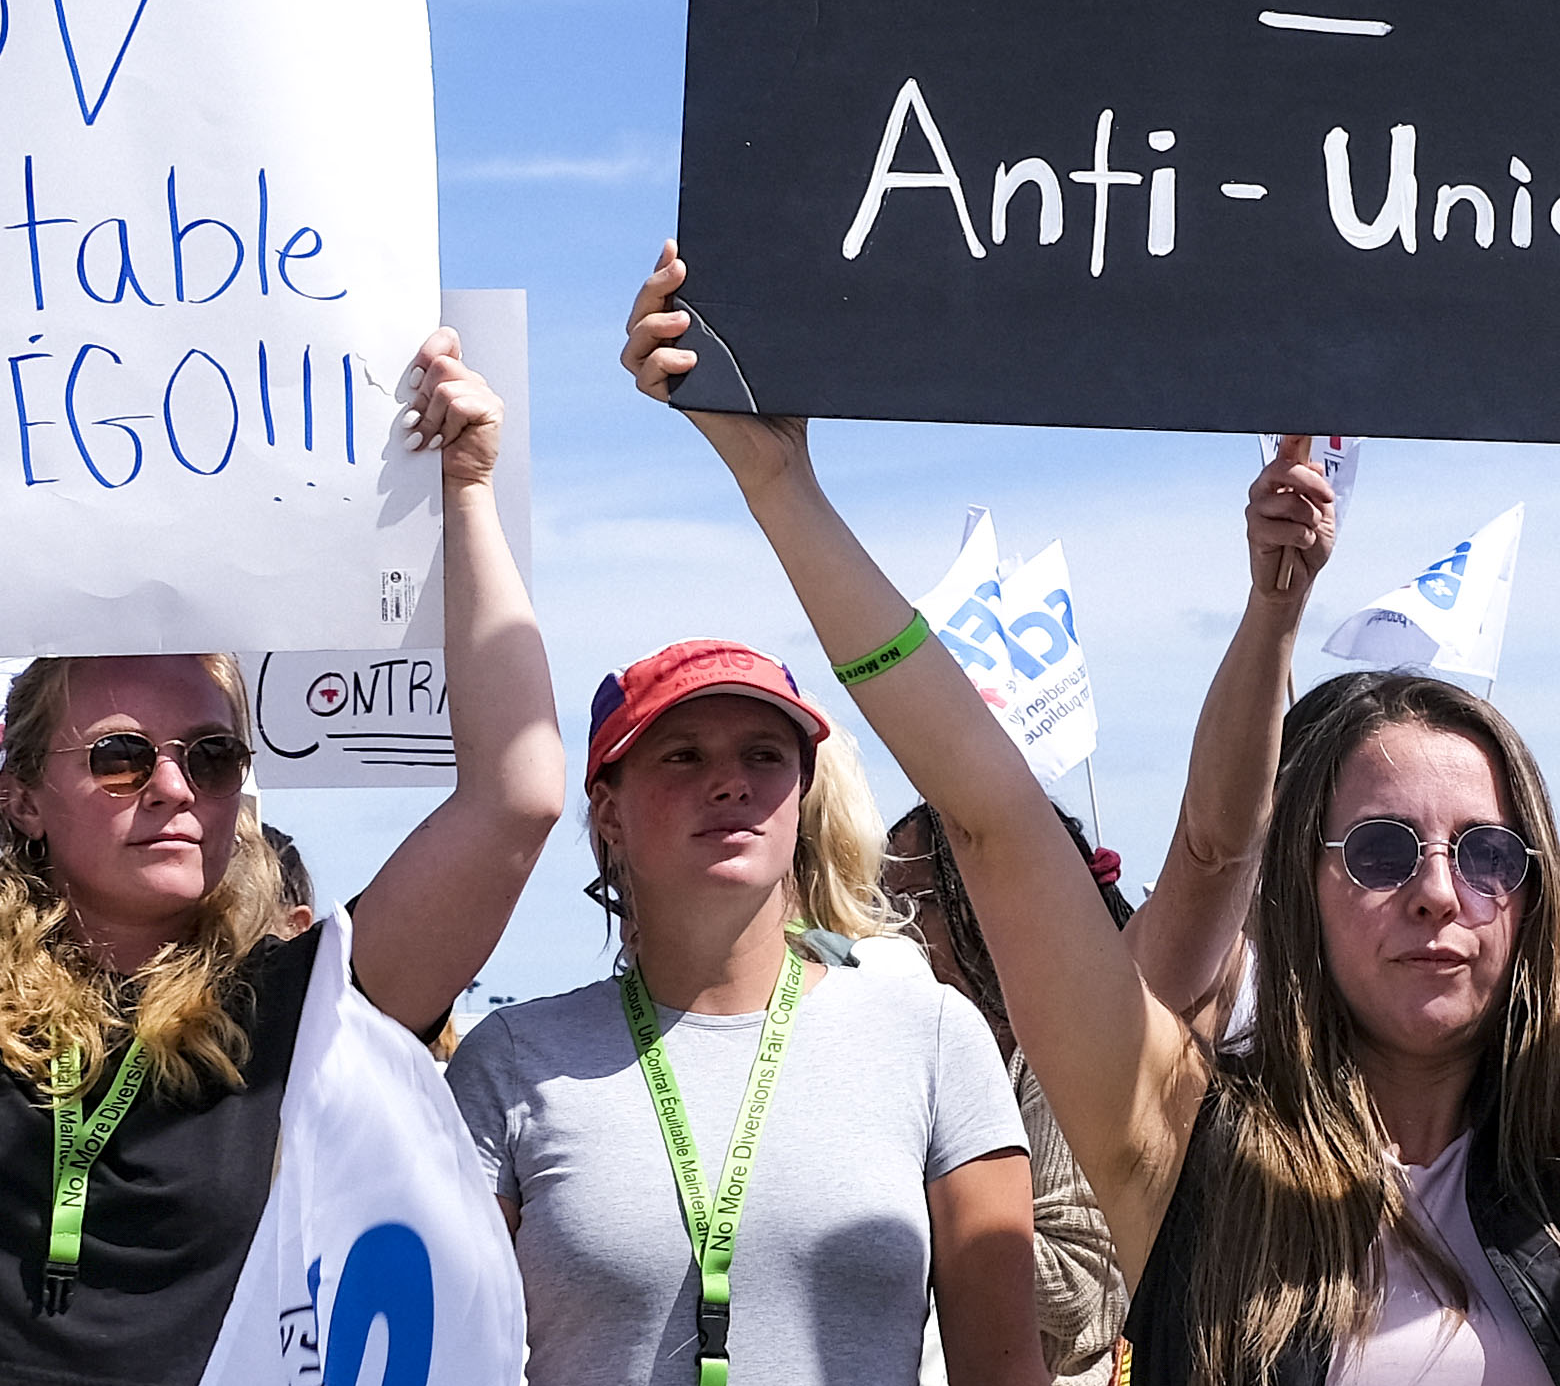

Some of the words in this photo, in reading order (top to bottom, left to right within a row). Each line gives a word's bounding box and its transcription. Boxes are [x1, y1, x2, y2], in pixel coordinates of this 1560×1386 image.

[4, 155, 351, 312] table
[770, 957, 803, 1026] Contract
[637, 1024, 654, 1047] Un
[759, 1032, 786, 1065] Fair
[644, 1047, 672, 1099] Contrat
[70, 1122, 112, 1175] More
[659, 1097, 690, 1158] Équitable
[61, 1177, 85, 1208] No
[718, 1164, 749, 1216] More
[709, 1220, 735, 1253] No
